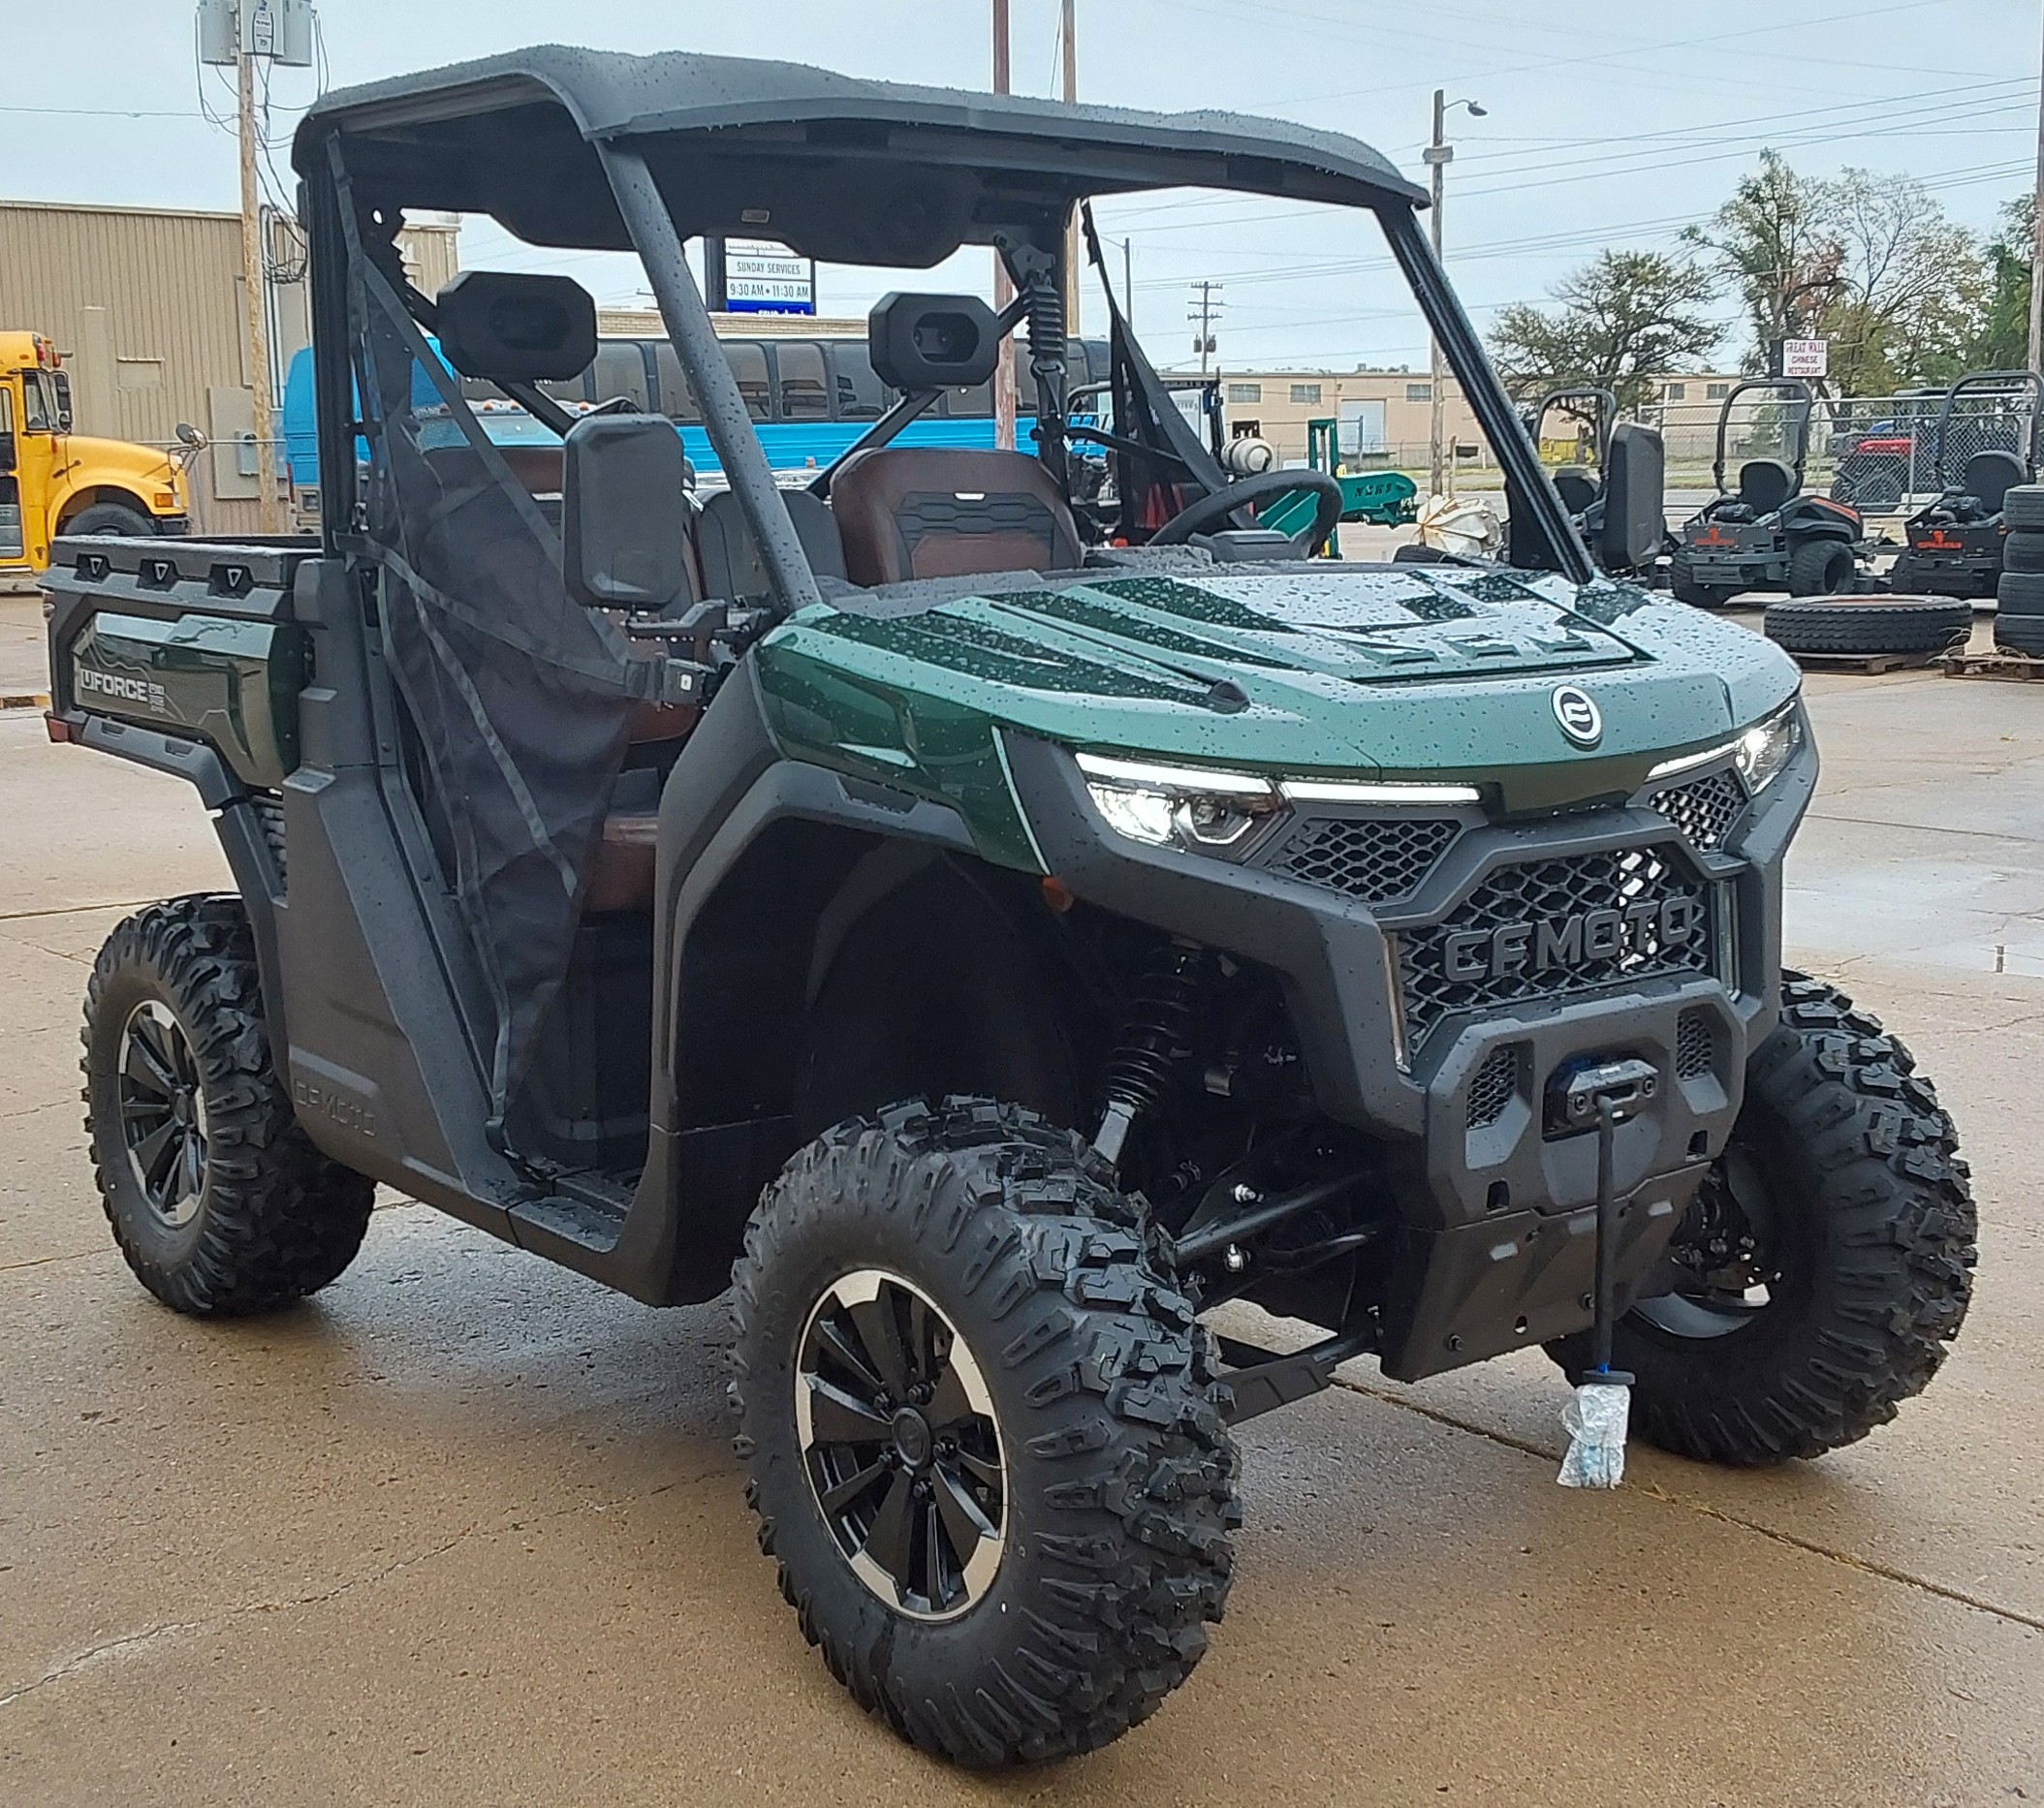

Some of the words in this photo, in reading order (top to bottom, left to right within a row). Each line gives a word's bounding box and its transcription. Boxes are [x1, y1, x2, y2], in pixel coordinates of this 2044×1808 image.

[737, 261, 765, 274] SUNDAY
[767, 263, 801, 275] SERVICES
[730, 283, 749, 296] 9:30
[751, 284, 765, 296] AM
[772, 285, 794, 297] 11:30
[796, 286, 809, 298] AM
[80, 669, 148, 702] UFORCE
[1445, 894, 1694, 983] CFMOTO
